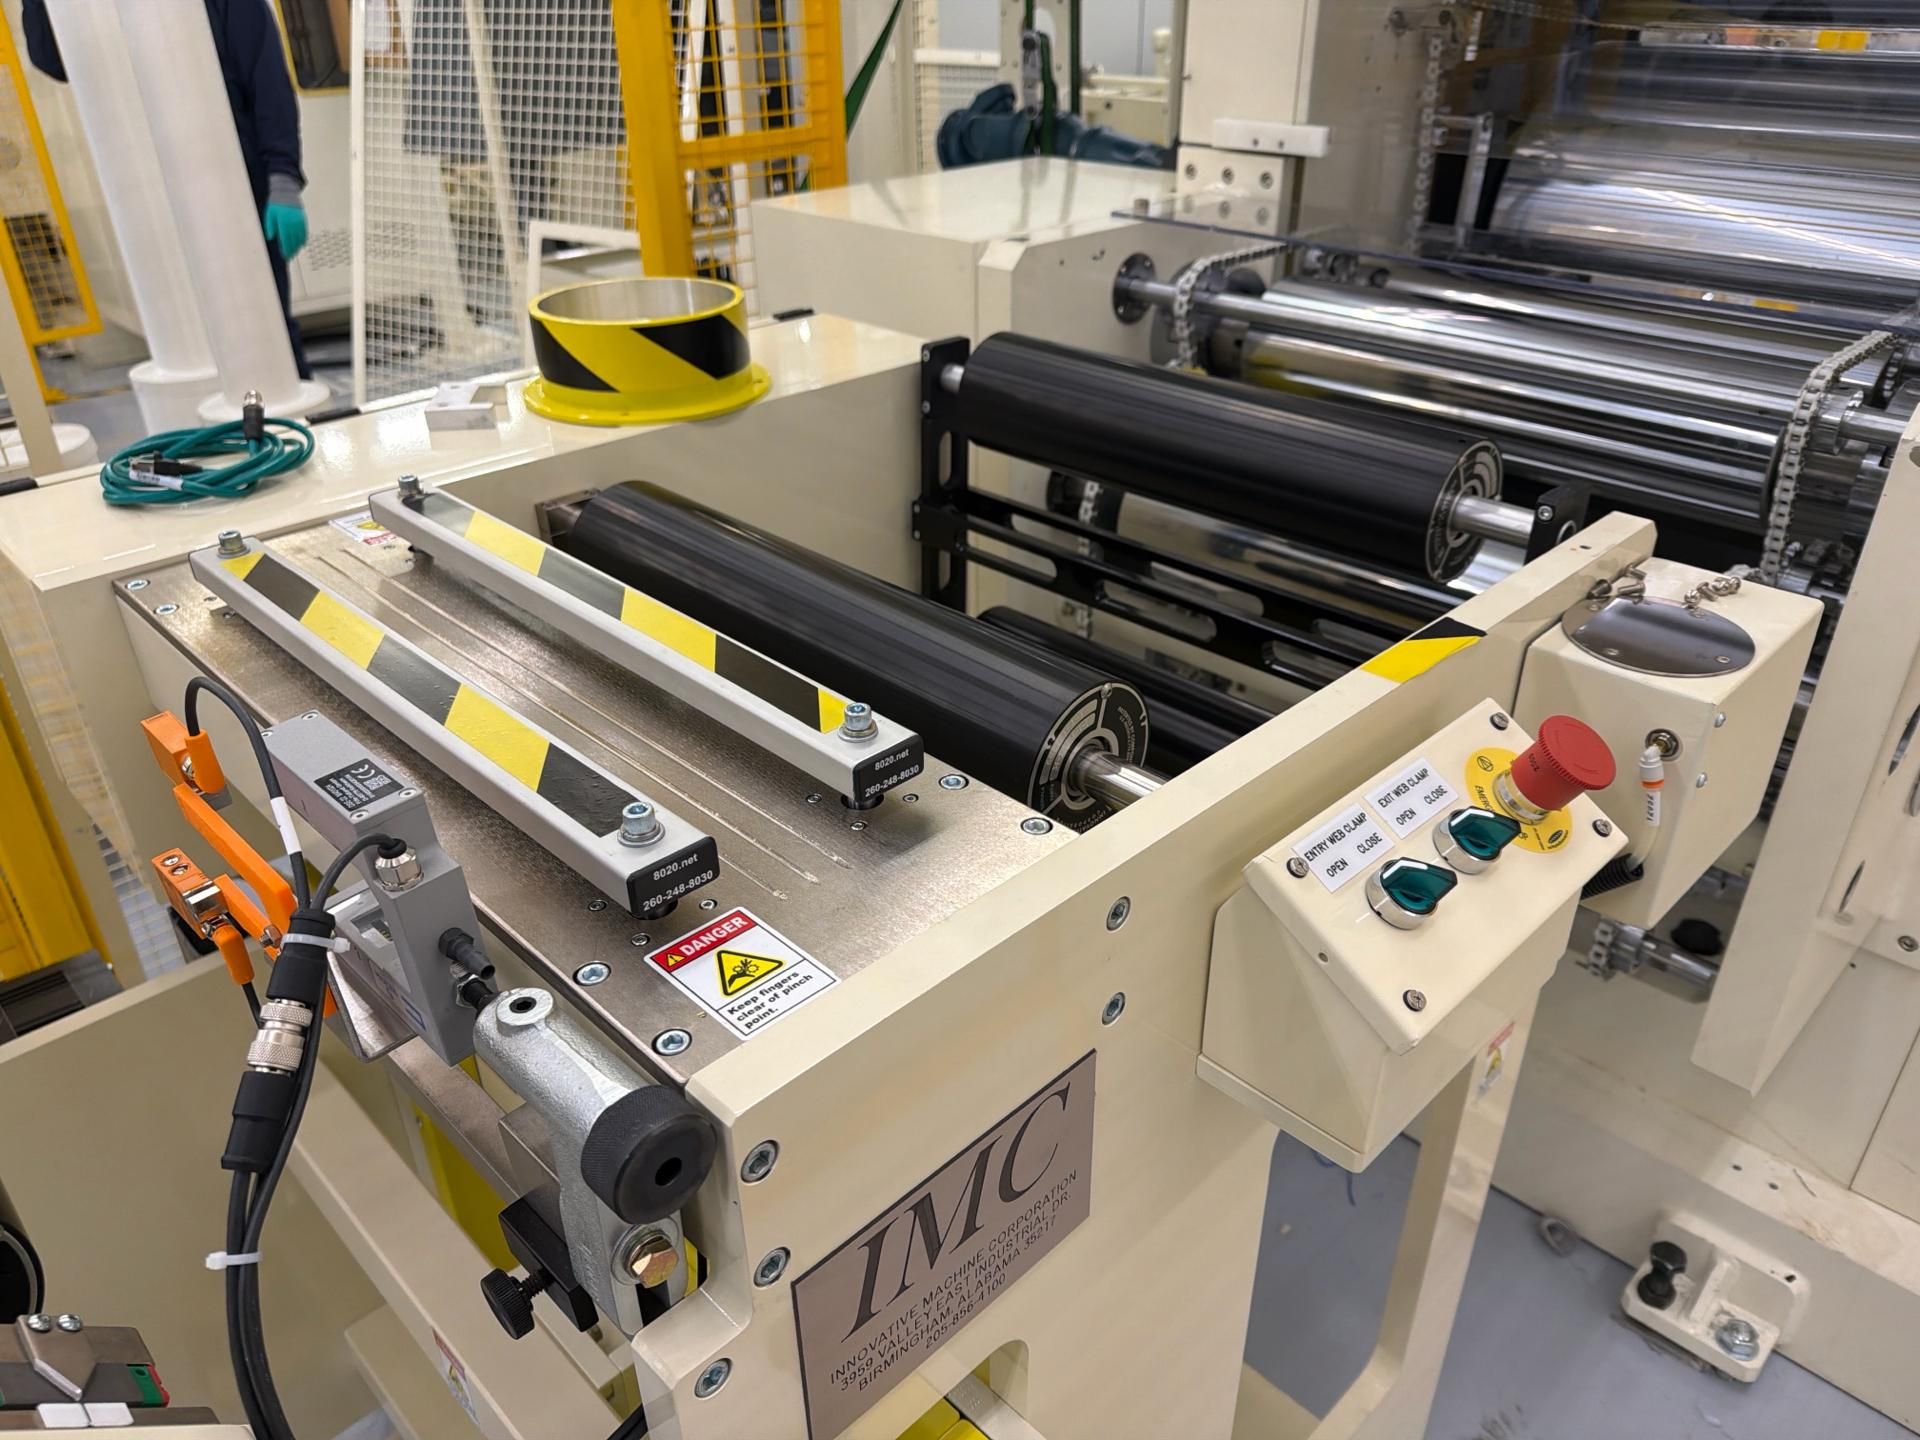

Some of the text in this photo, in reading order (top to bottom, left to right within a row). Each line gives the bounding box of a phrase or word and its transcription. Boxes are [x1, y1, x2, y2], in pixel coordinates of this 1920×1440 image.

[865, 764, 919, 797] 260-248-8030
[874, 748, 909, 771] 8020.net
[1377, 768, 1429, 808] EXIT WEB CLAMP
[1395, 784, 1448, 826] OPEN CLOSE
[1304, 812, 1367, 862] ENTRY WEB CLAMP
[1326, 832, 1383, 878] OPEN CLOSE
[653, 853, 698, 880] 8020.net
[643, 870, 713, 911] 260-248-8030
[680, 916, 748, 956] DANGER
[727, 971, 800, 1015] Keep fingers
[737, 974, 813, 1022] clear of pinch
[744, 1007, 779, 1030] point.
[841, 1082, 1070, 1344] IMC
[830, 1169, 1077, 1385] INNOVATIVE MACHINE CORPORATION
[957, 1247, 1021, 1308] ALABAMA
[1023, 1214, 1056, 1250] 35217
[841, 1191, 1071, 1392] 3959 VALLEY EAST INDUSTRIAL DR.
[926, 1272, 1006, 1350] 205-856-4100
